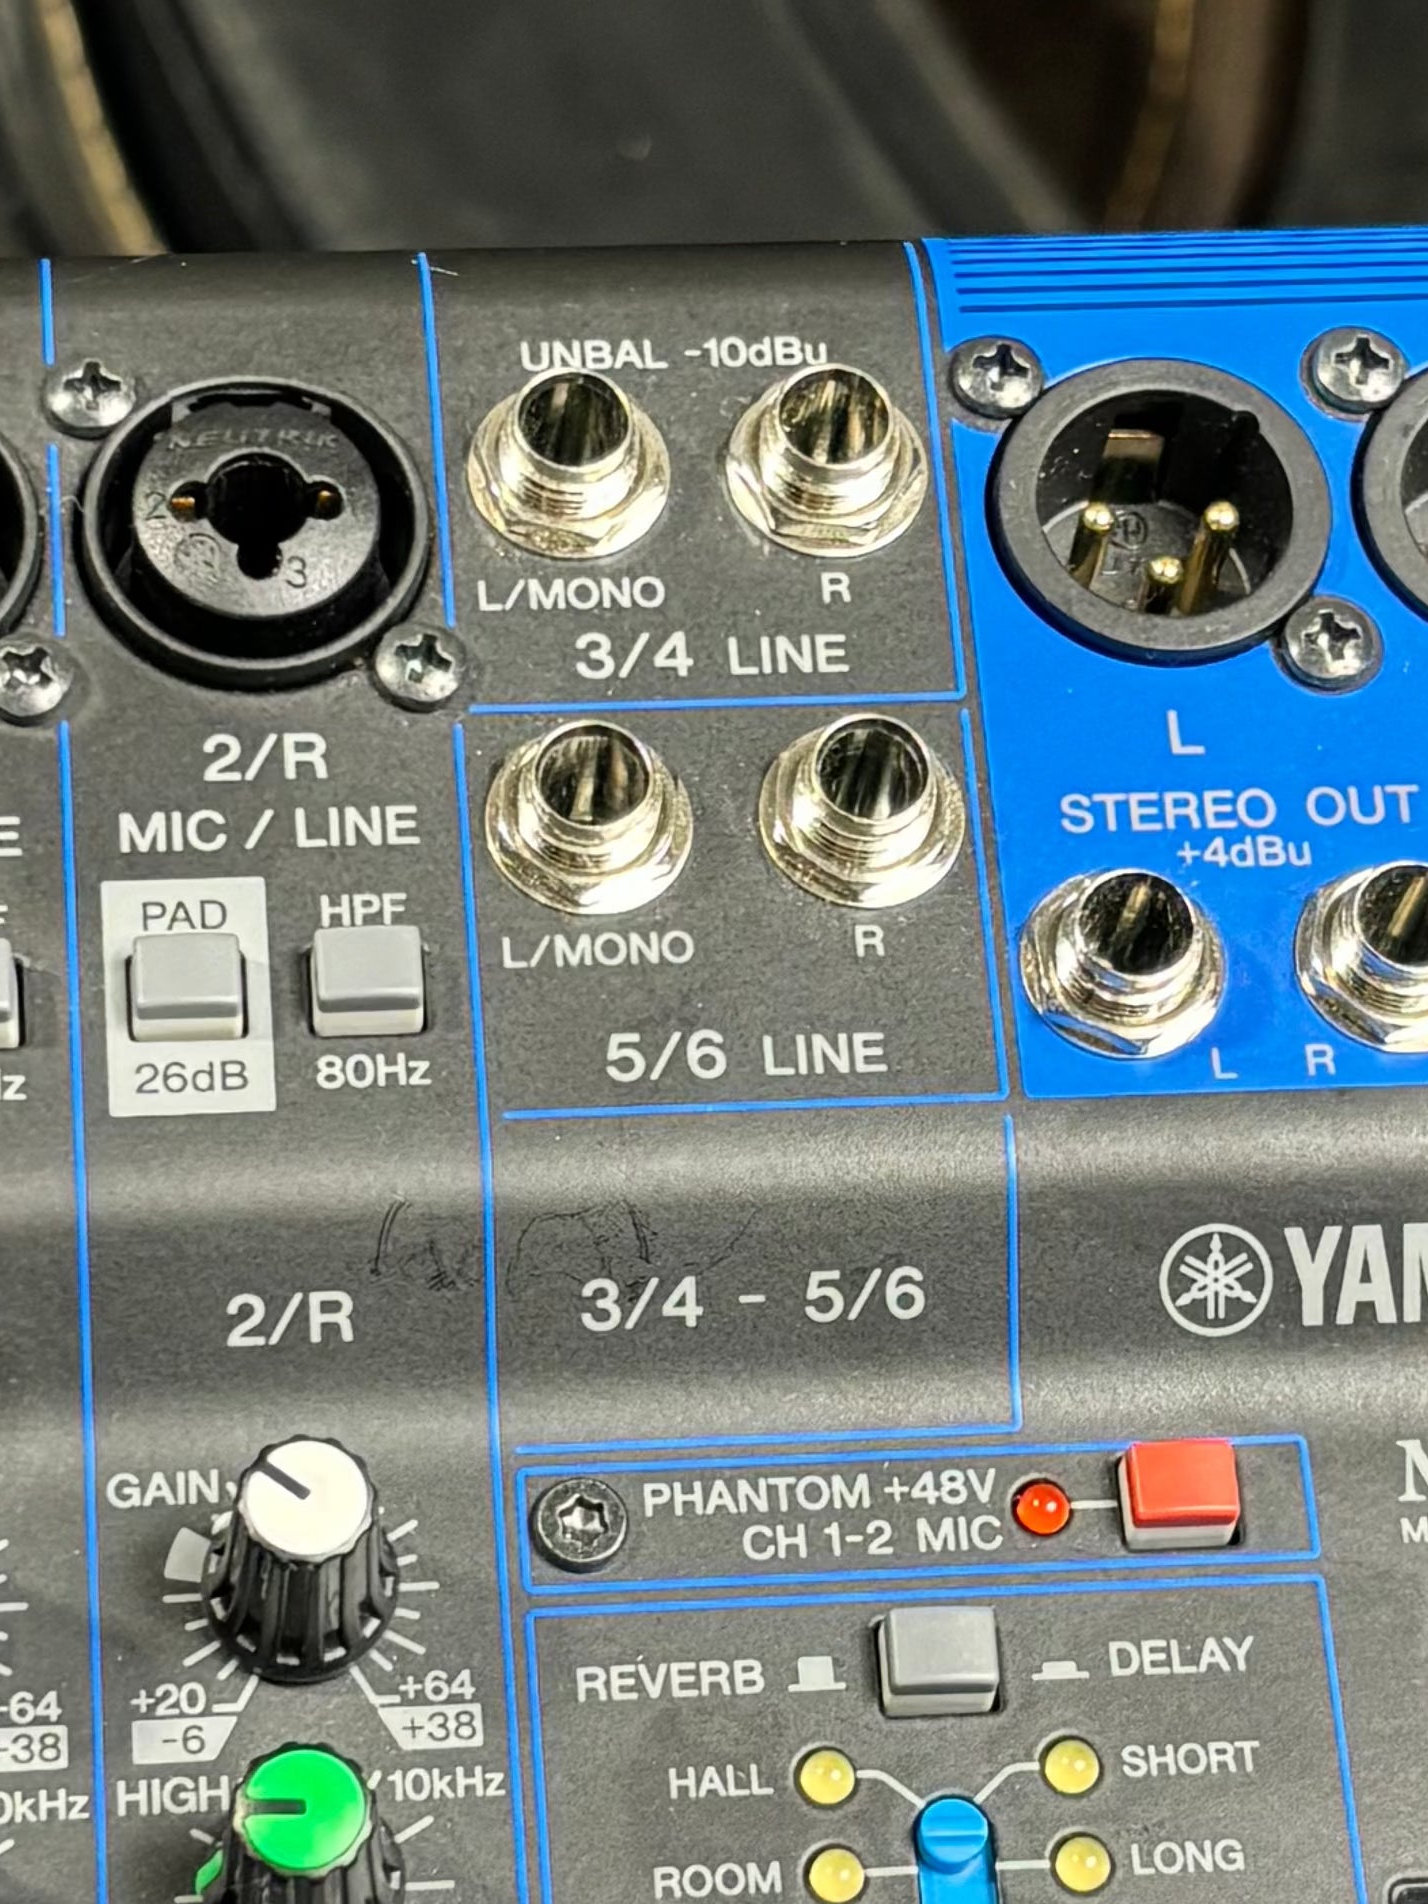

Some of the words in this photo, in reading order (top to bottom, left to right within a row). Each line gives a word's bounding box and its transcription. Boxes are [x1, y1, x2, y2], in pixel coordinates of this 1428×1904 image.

[520, 338, 669, 372] UNBAL
[683, 335, 827, 367] -10dBu
[286, 555, 307, 588] 3
[820, 571, 852, 604] R
[477, 575, 665, 612] L/MONO
[575, 630, 694, 680] 3/4
[727, 633, 850, 676] LINE
[1167, 709, 1206, 755] L
[202, 732, 329, 782] 2/R
[1060, 787, 1277, 834] STEREO
[1306, 784, 1419, 827] OUT
[118, 809, 227, 854] MIC
[244, 808, 275, 850] /
[294, 804, 421, 848] LINE
[1176, 834, 1312, 868] +4dBu
[141, 899, 228, 932] PAD
[320, 894, 408, 927] HPF
[501, 929, 695, 969] L/MONO
[854, 924, 885, 958] R
[316, 1052, 432, 1090] 80Hz
[606, 1028, 727, 1083] 5/6
[762, 1031, 888, 1076] LINE
[1211, 1047, 1239, 1080] L
[1304, 1043, 1336, 1076] R
[134, 1059, 249, 1094] 26dB
[580, 1275, 704, 1332] 3/4
[804, 1265, 926, 1323] 5/6
[226, 1290, 354, 1347] 2/R
[106, 1468, 219, 1509] GAIN
[643, 1473, 871, 1518] PHANTOM
[883, 1467, 996, 1505] +48V
[742, 1523, 808, 1561] CH
[823, 1519, 894, 1557] 1-2
[916, 1514, 1004, 1553] MIC
[1108, 1635, 1254, 1677] DELAY
[130, 1681, 207, 1717] +20
[398, 1668, 476, 1703] +64
[576, 1658, 765, 1703] REVERB
[161, 1724, 206, 1755] -6
[401, 1709, 477, 1742] +38
[1120, 1740, 1261, 1778] SHORT
[116, 1774, 230, 1817] HIGH
[386, 1765, 506, 1802] 10kHz
[668, 1763, 775, 1800] HALL
[1130, 1838, 1246, 1876] LONG
[653, 1860, 783, 1901] ROOM
